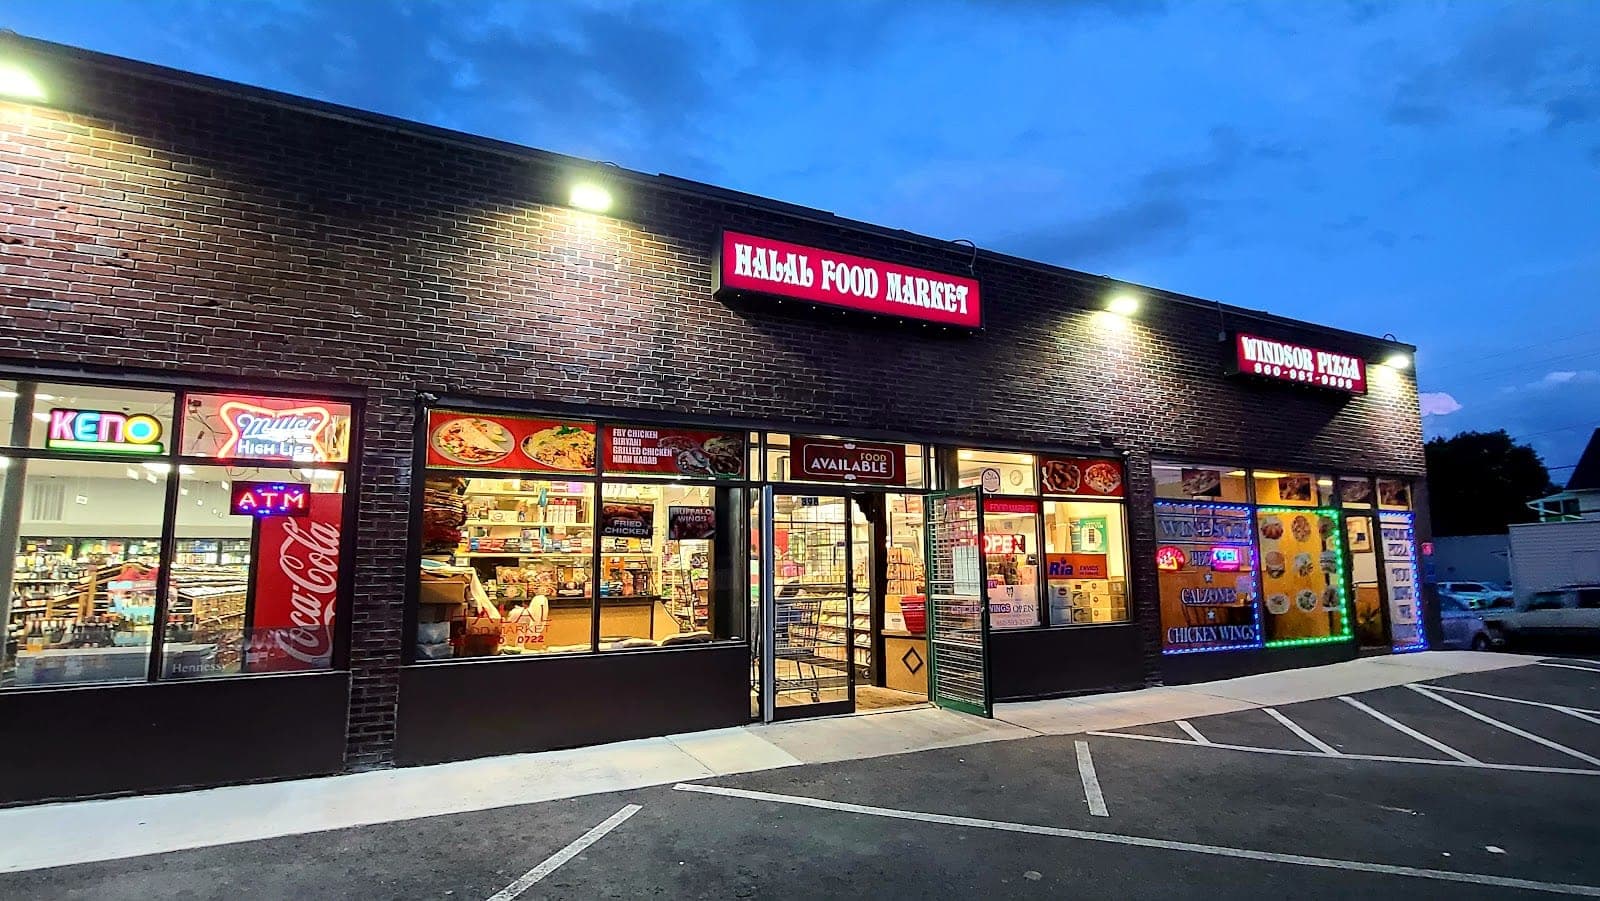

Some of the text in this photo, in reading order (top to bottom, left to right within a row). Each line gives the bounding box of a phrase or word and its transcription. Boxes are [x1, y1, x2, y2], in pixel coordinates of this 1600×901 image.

[734, 242, 969, 314] HALAL FOOD MARKET
[1241, 336, 1361, 380] WINDSOR PIZZA
[237, 413, 320, 438] Miller
[612, 428, 658, 439] FRY CHICKEN
[238, 439, 275, 455] HIGH
[612, 437, 642, 446] BIRYANI
[612, 446, 673, 457] GRILLED CHICKEN
[860, 453, 887, 462] FOOD
[811, 457, 888, 473] AVAILABLE
[238, 492, 304, 508] ATM
[604, 526, 649, 535] CHICKEN
[613, 519, 642, 527] FRIED
[1049, 557, 1074, 576] Ria
[1181, 588, 1237, 604] CALZONES
[1167, 625, 1255, 644] CHICKEN WINGS
